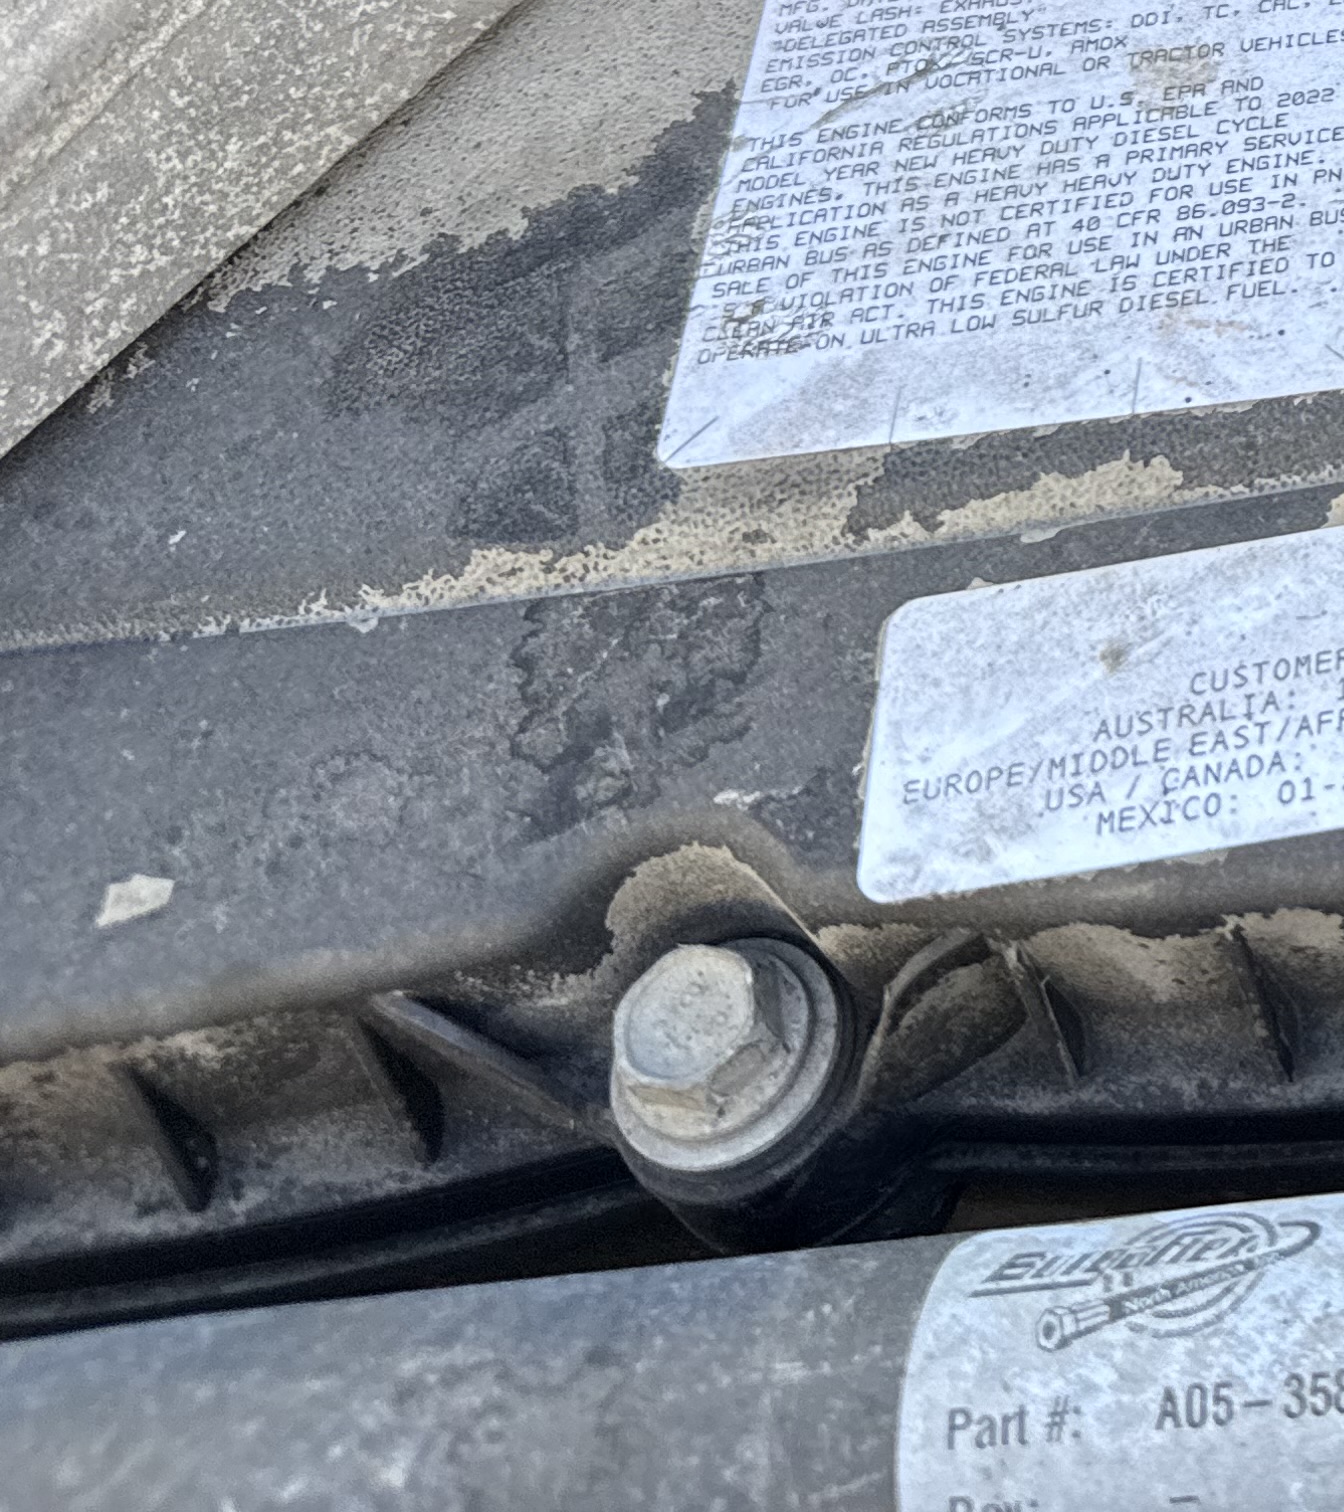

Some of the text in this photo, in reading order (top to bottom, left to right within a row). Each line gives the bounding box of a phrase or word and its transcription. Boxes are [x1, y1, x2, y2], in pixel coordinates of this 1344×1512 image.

[764, 17, 1113, 72] EMISSION CONTROL SYSTEMS:
[855, 3, 923, 25] LASH:
[1070, 33, 1127, 54] AMOX
[924, 60, 1067, 92] VOCATIONAL
[1081, 55, 1110, 73] OR
[1124, 41, 1224, 68] TRACTOR
[739, 86, 1334, 172] CALIFORNIA REGULATIONS APPLICABLE TO 2022
[744, 130, 801, 152] THIS
[815, 118, 902, 144] ENGINE
[1046, 97, 1076, 115] TO
[1162, 81, 1206, 101] EPA
[1220, 74, 1264, 94] AND
[733, 111, 1288, 193] MODEL YEAR NEW HEAVY DUTY DIESEL CYCLE
[859, 176, 919, 198] THIS
[933, 163, 1022, 189] ENGINE
[1036, 156, 1081, 177] HAS
[1095, 153, 1110, 170] A
[1125, 138, 1228, 166] PRIMARY
[900, 147, 1326, 213] AS A HEAVY HEAVY DUTY ENGINE.
[792, 171, 1297, 247] ENGINE IS NOT CERTIFIED FOR USE IN
[802, 245, 848, 266] BUS
[862, 240, 892, 259] AS
[907, 225, 1012, 254] DEFINED
[1026, 220, 1056, 239] AT
[1071, 215, 1101, 234] 40
[1116, 207, 1161, 229] CFR
[778, 234, 1290, 312] VIOLATION OF FEDERAL LAW UNDER THE
[782, 270, 814, 290] OF
[827, 261, 888, 285] THIS
[902, 249, 993, 275] ENGINE
[1007, 242, 1053, 263] FOR
[1068, 234, 1113, 256] USE
[1128, 229, 1158, 248] IN
[1173, 224, 1203, 243] AN
[1218, 213, 1292, 238] URBAN
[813, 276, 1298, 351] ON ULTRA LOW SULFUR DIESEL FUEL.
[849, 250, 1333, 325] ACT. THIS ENGINE IS CERTIFIED TO
[1091, 684, 1296, 744] AUSTRALIA:
[901, 735, 1171, 808] EUROPE/MIDDLE
[1043, 778, 1108, 815] USA
[1159, 745, 1303, 795] CANADA:
[1095, 787, 1239, 839] MEXICO:
[946, 1402, 1028, 1450] Part
[1044, 1396, 1083, 1443] #:
